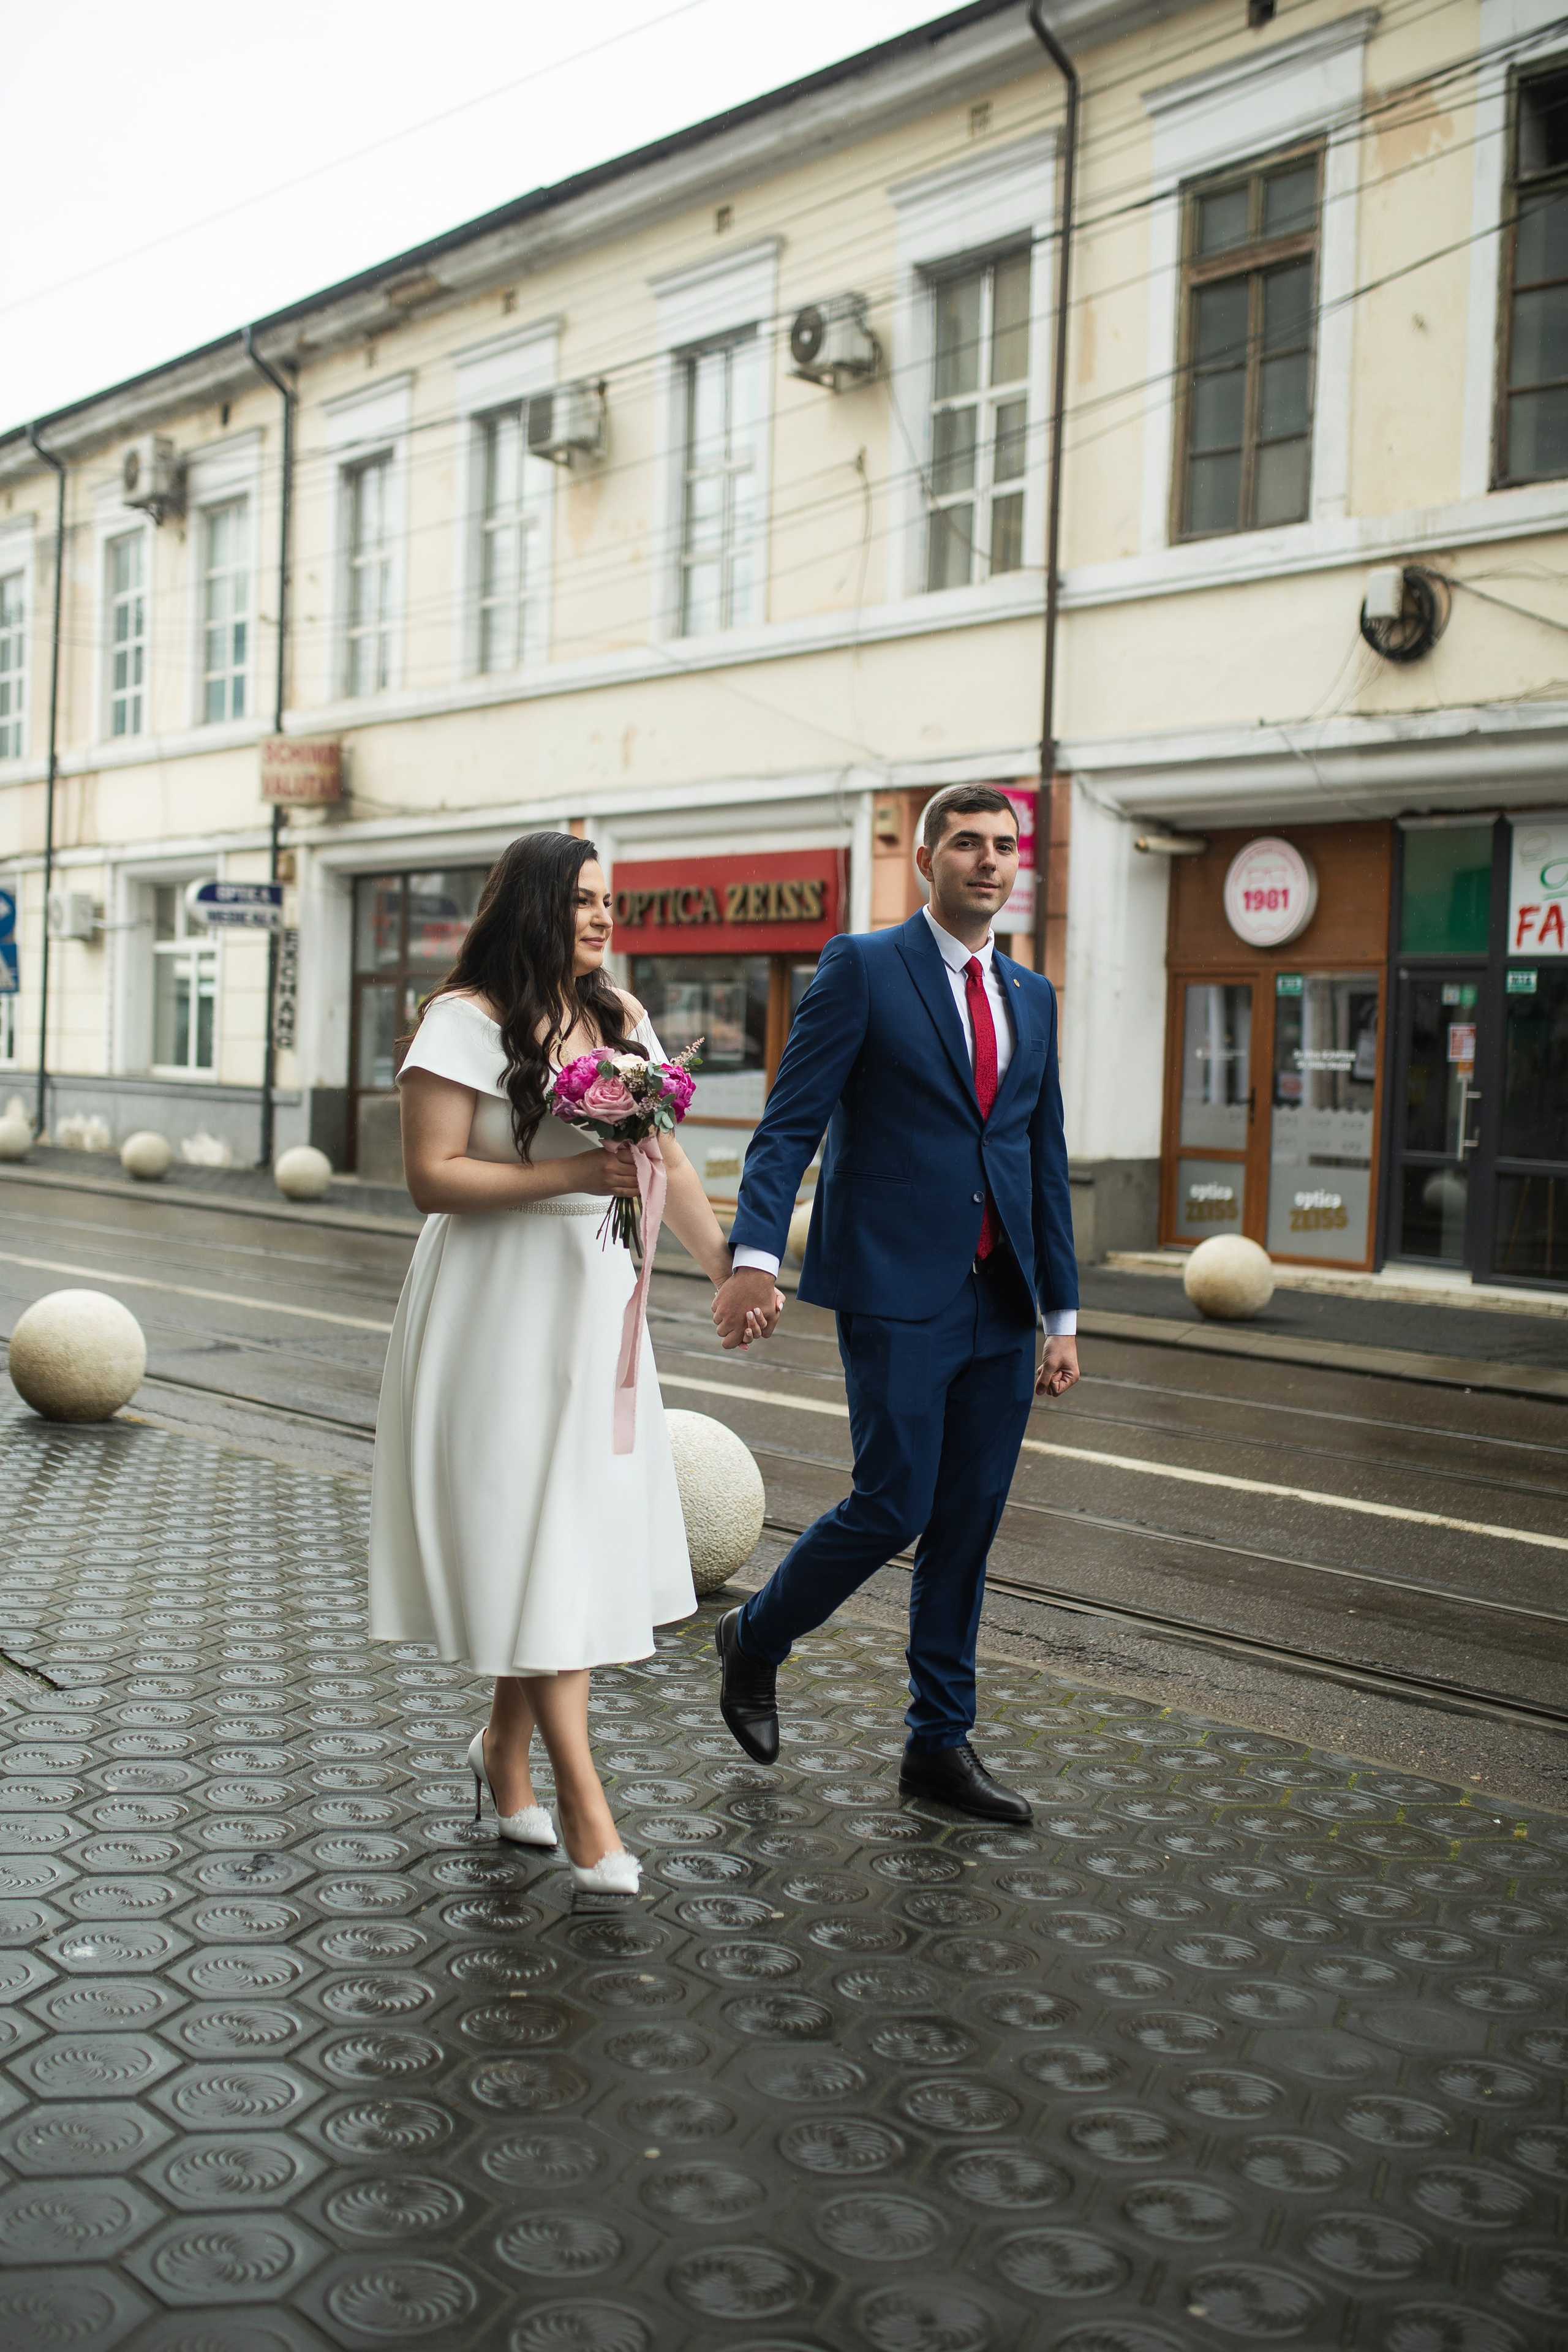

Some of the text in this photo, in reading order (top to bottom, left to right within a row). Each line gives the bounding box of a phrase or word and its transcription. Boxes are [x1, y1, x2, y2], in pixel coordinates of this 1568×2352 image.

[615, 880, 823, 925] OPTICA ZEISS
[1243, 887, 1289, 912] 1981
[1185, 1199, 1238, 1223] ZEISS
[1294, 1188, 1342, 1210] optica
[1289, 1205, 1349, 1232] ZEISS
